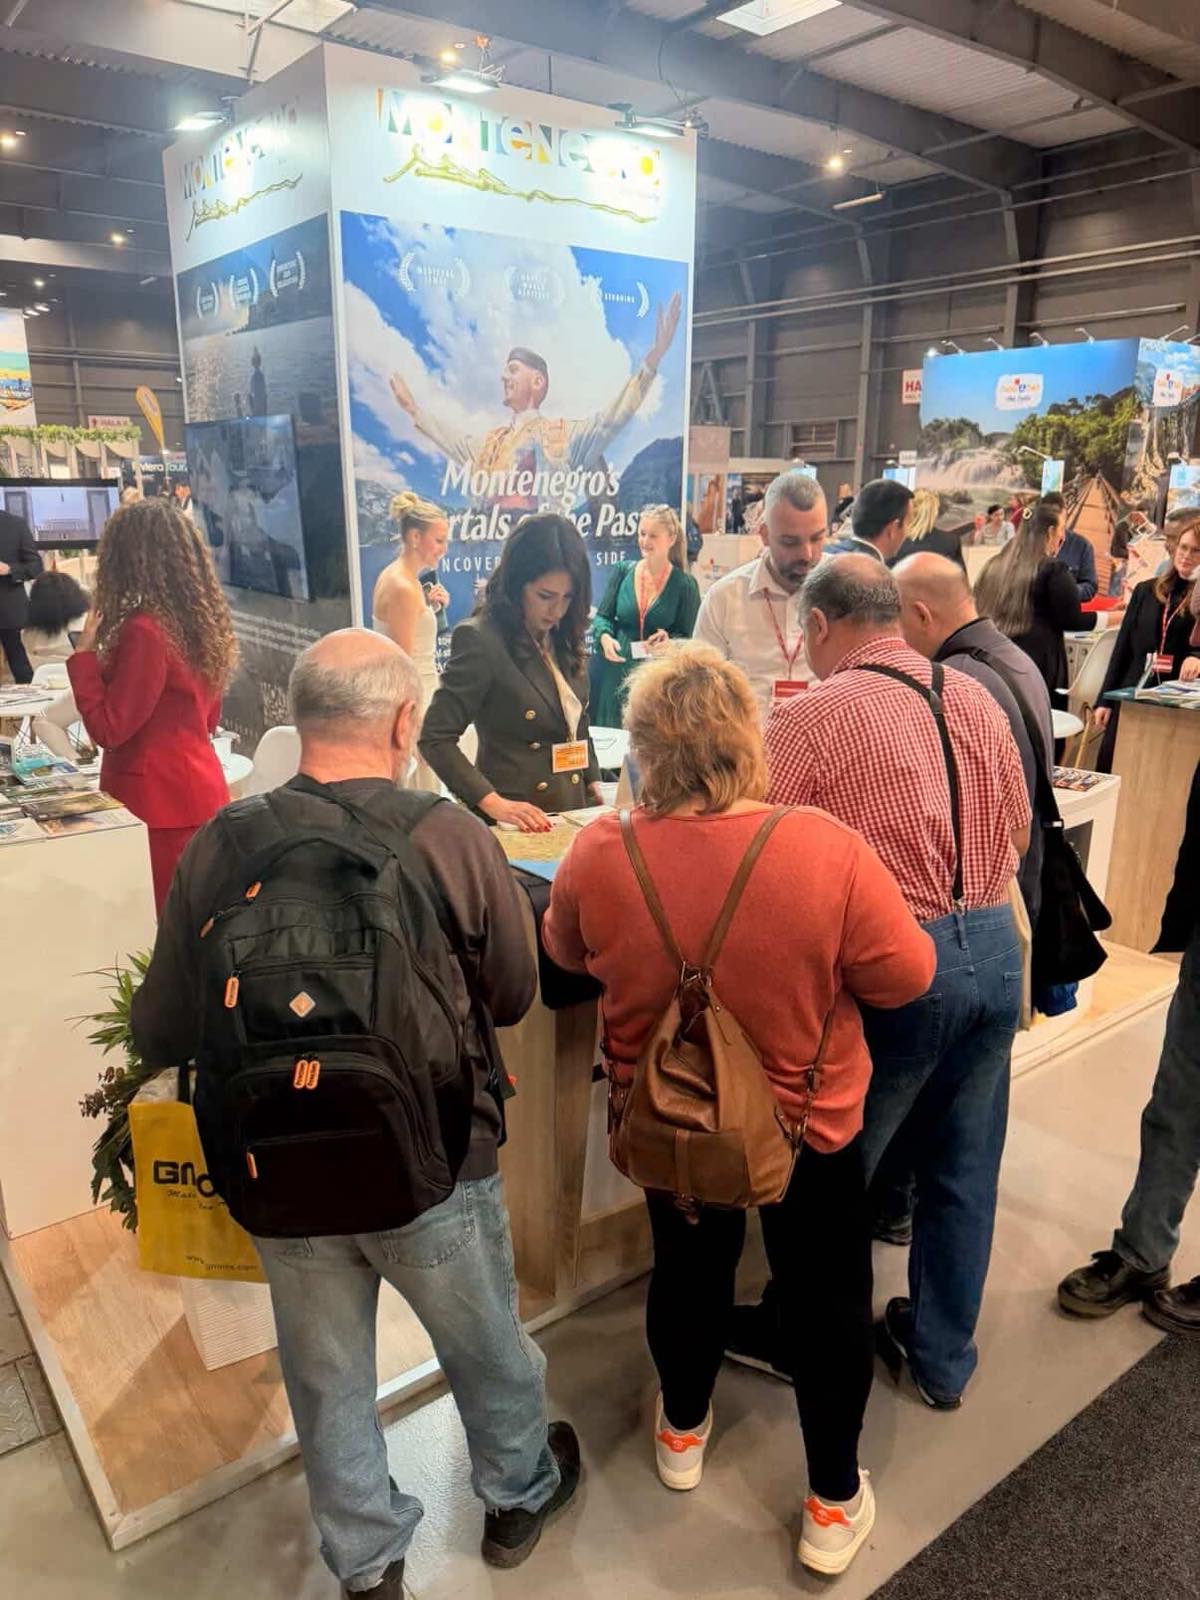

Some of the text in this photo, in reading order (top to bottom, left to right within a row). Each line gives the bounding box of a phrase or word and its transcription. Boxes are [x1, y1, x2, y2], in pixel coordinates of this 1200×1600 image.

[441, 460, 620, 505] Montenegro's
[448, 503, 511, 541] rtals
[595, 503, 639, 537] Pas
